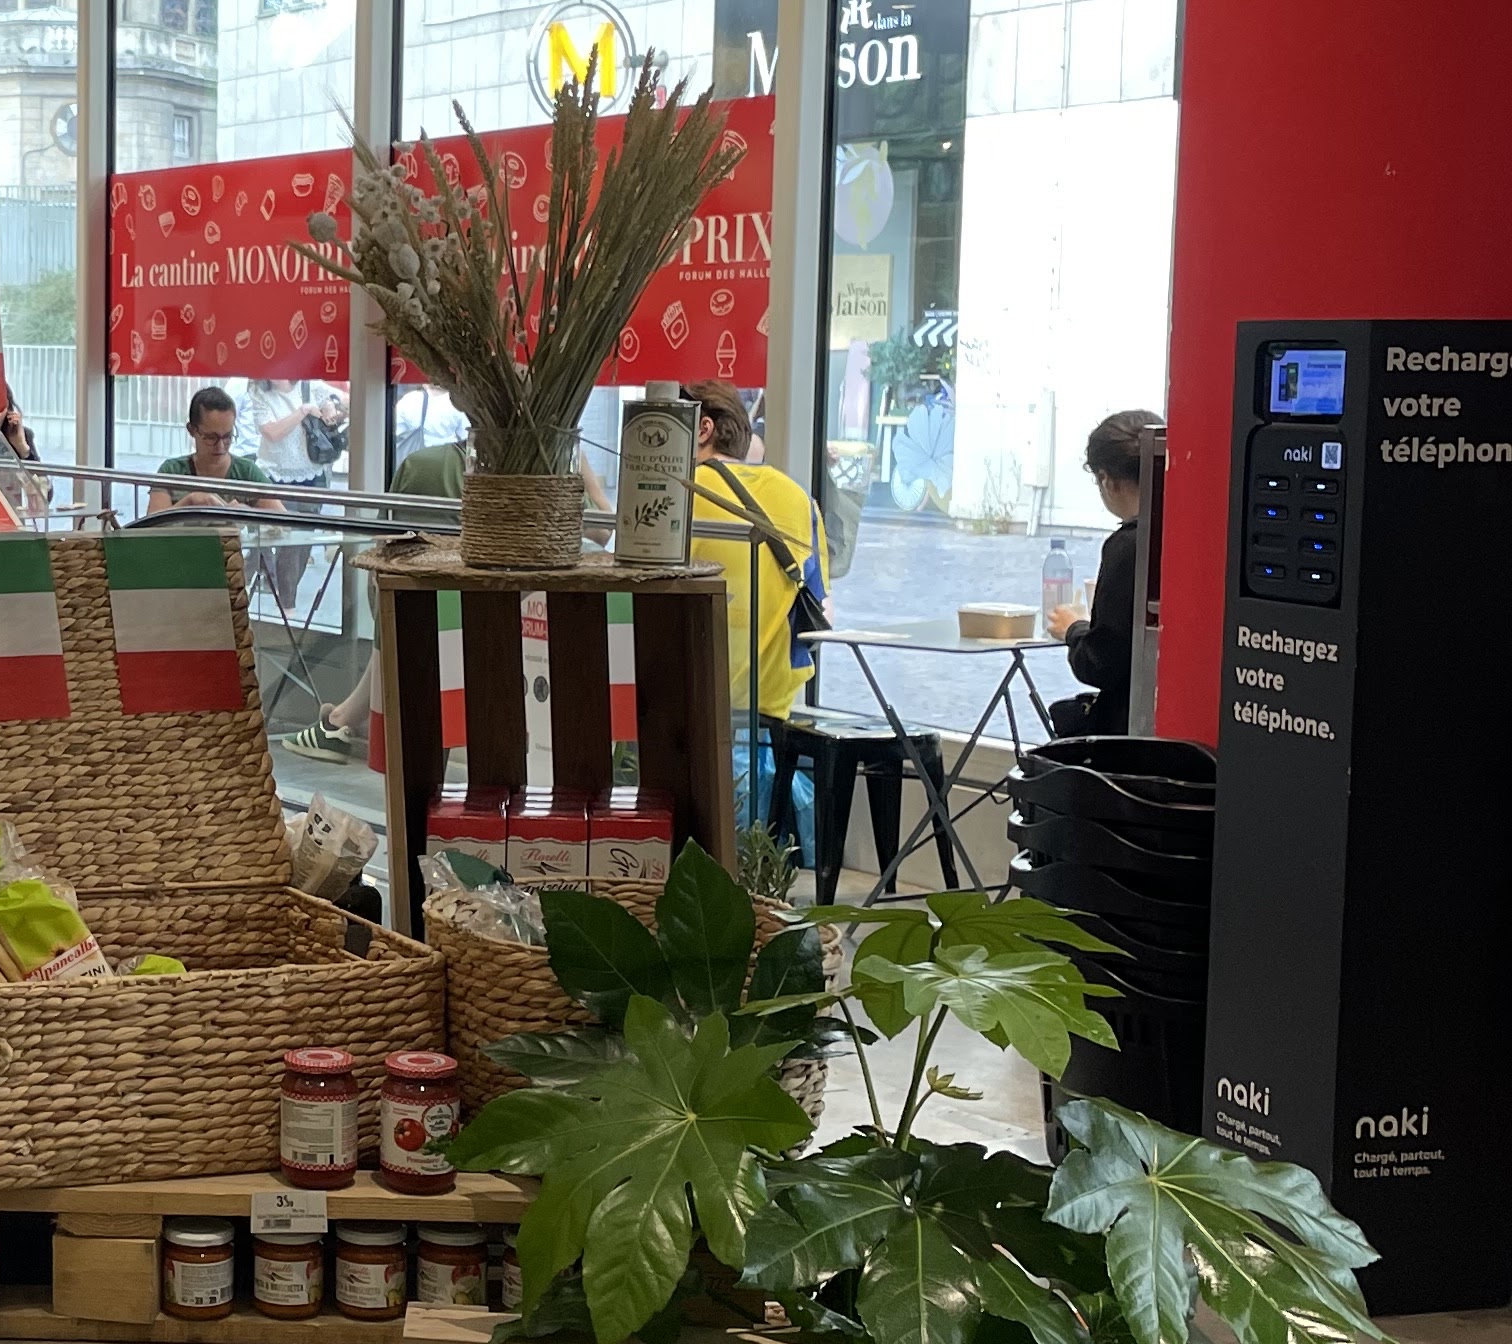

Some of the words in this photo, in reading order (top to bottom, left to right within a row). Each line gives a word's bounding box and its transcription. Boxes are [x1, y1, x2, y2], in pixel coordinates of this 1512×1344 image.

[121, 253, 144, 288] La
[148, 250, 220, 287] cantine
[225, 240, 352, 285] MONOPRI
[1387, 345, 1512, 378] Recharg
[1383, 393, 1461, 417] votre
[1237, 625, 1338, 662] Rechargez
[1235, 665, 1285, 692] votre
[1233, 700, 1336, 741] téléphone.
[1217, 1077, 1270, 1116] naki
[1355, 1105, 1429, 1139] naki
